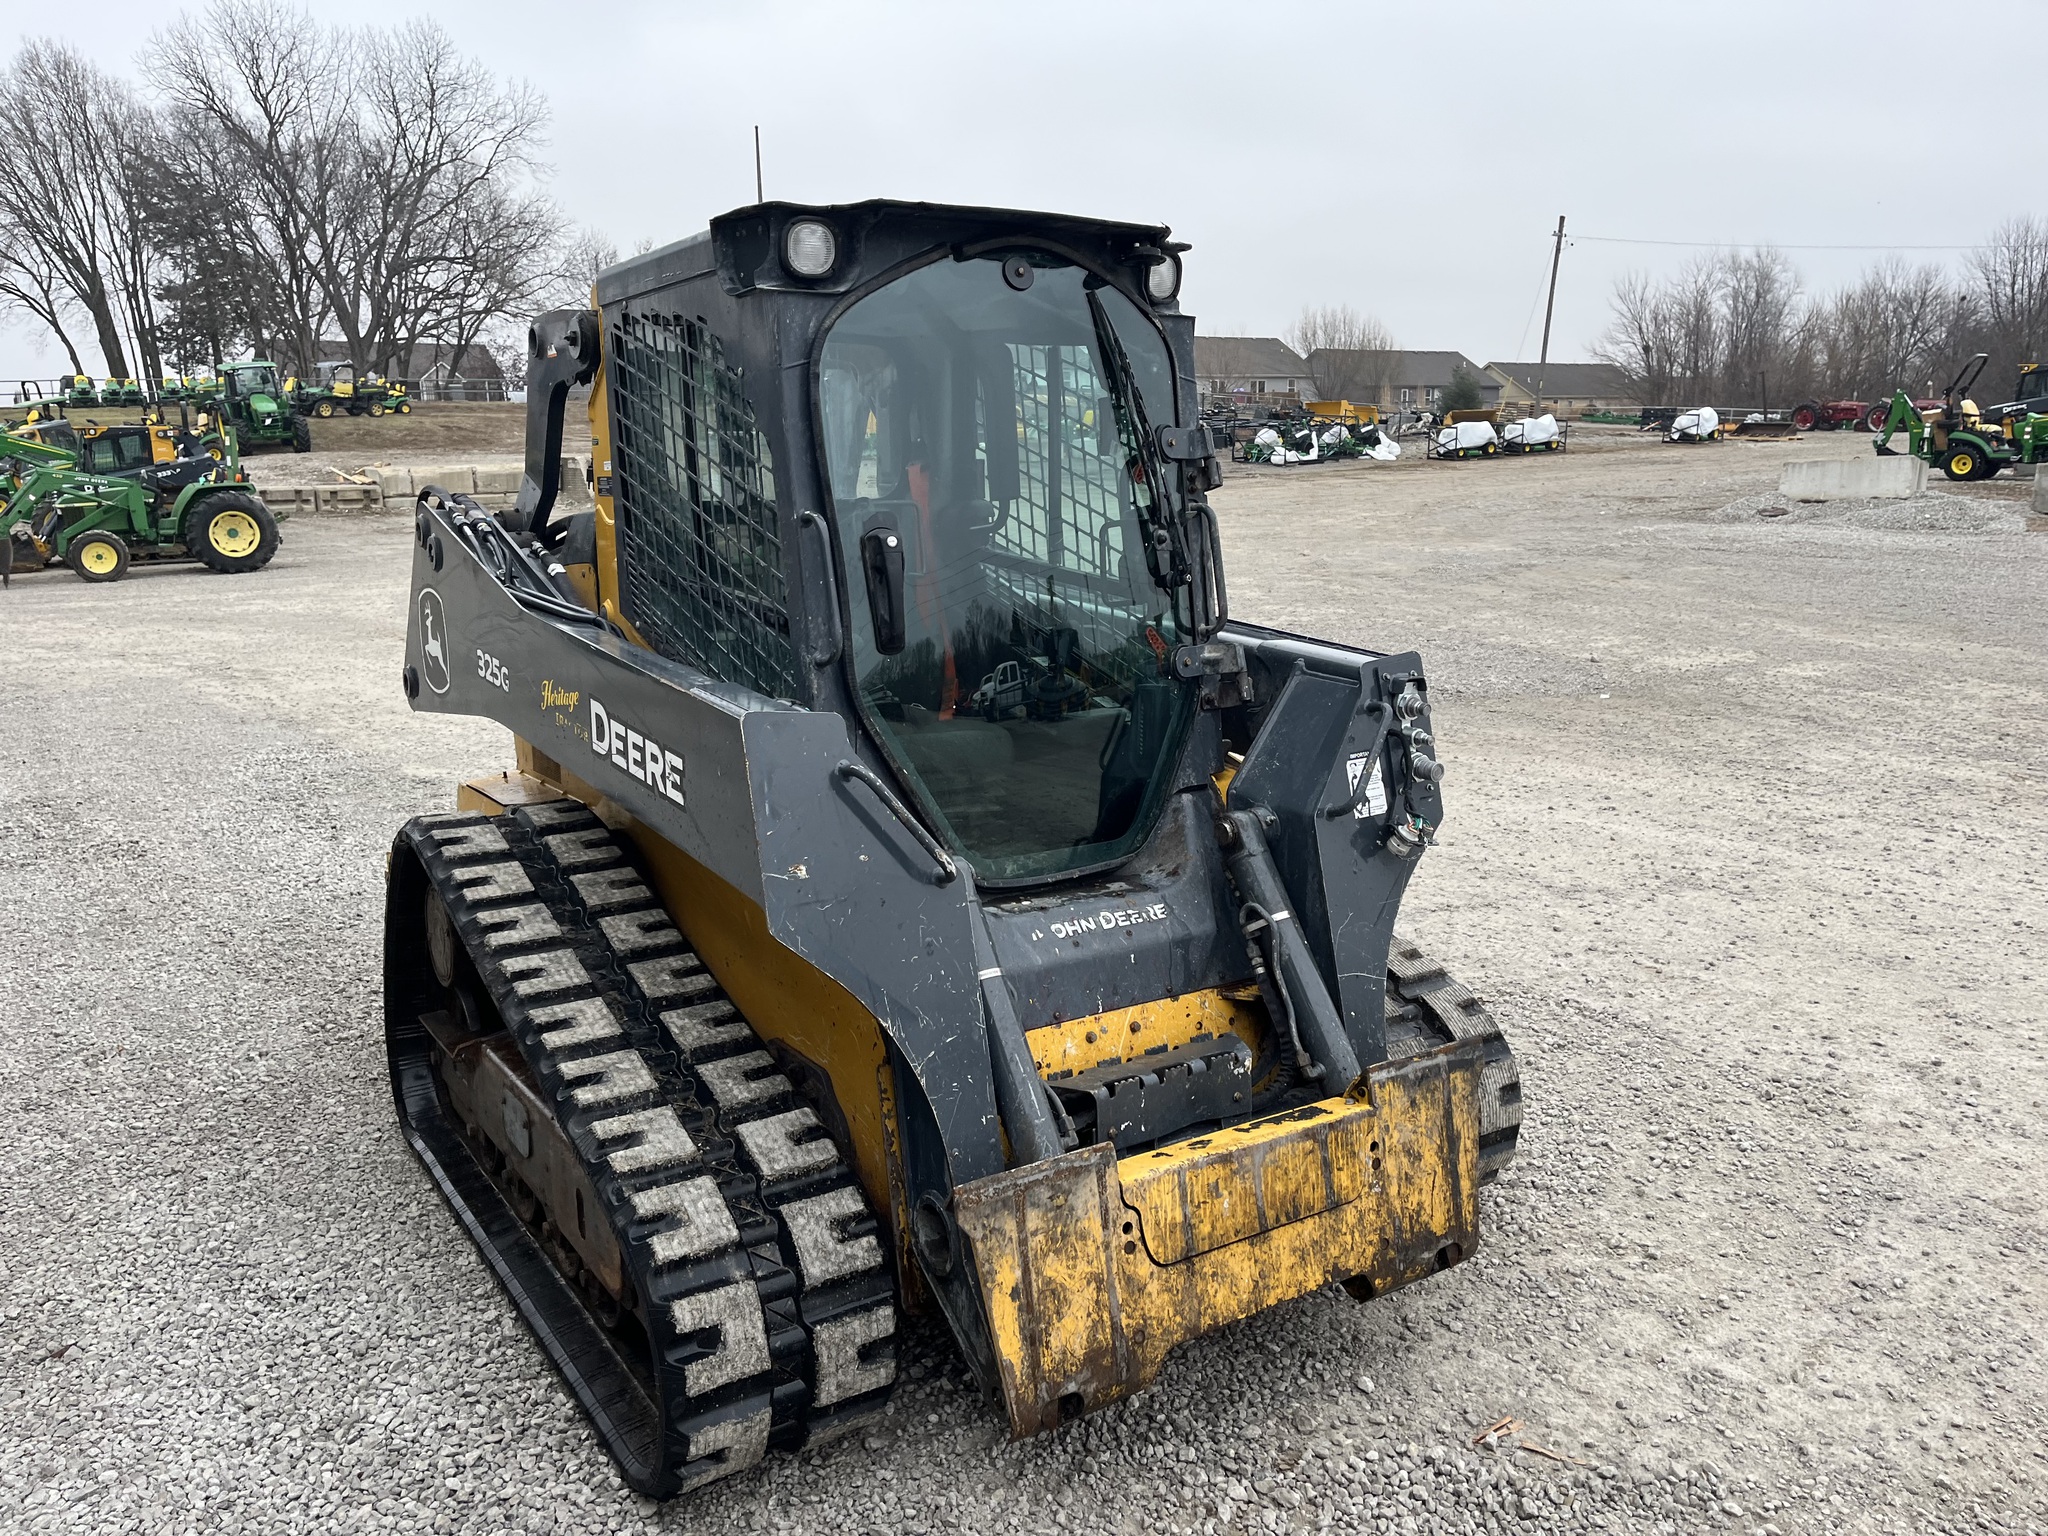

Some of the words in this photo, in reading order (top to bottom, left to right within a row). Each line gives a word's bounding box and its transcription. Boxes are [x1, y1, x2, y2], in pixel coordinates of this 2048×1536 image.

[477, 649, 509, 692] 325G
[541, 679, 579, 712] Heritage
[590, 698, 684, 806] DEERE
[1099, 903, 1167, 930] DEERE
